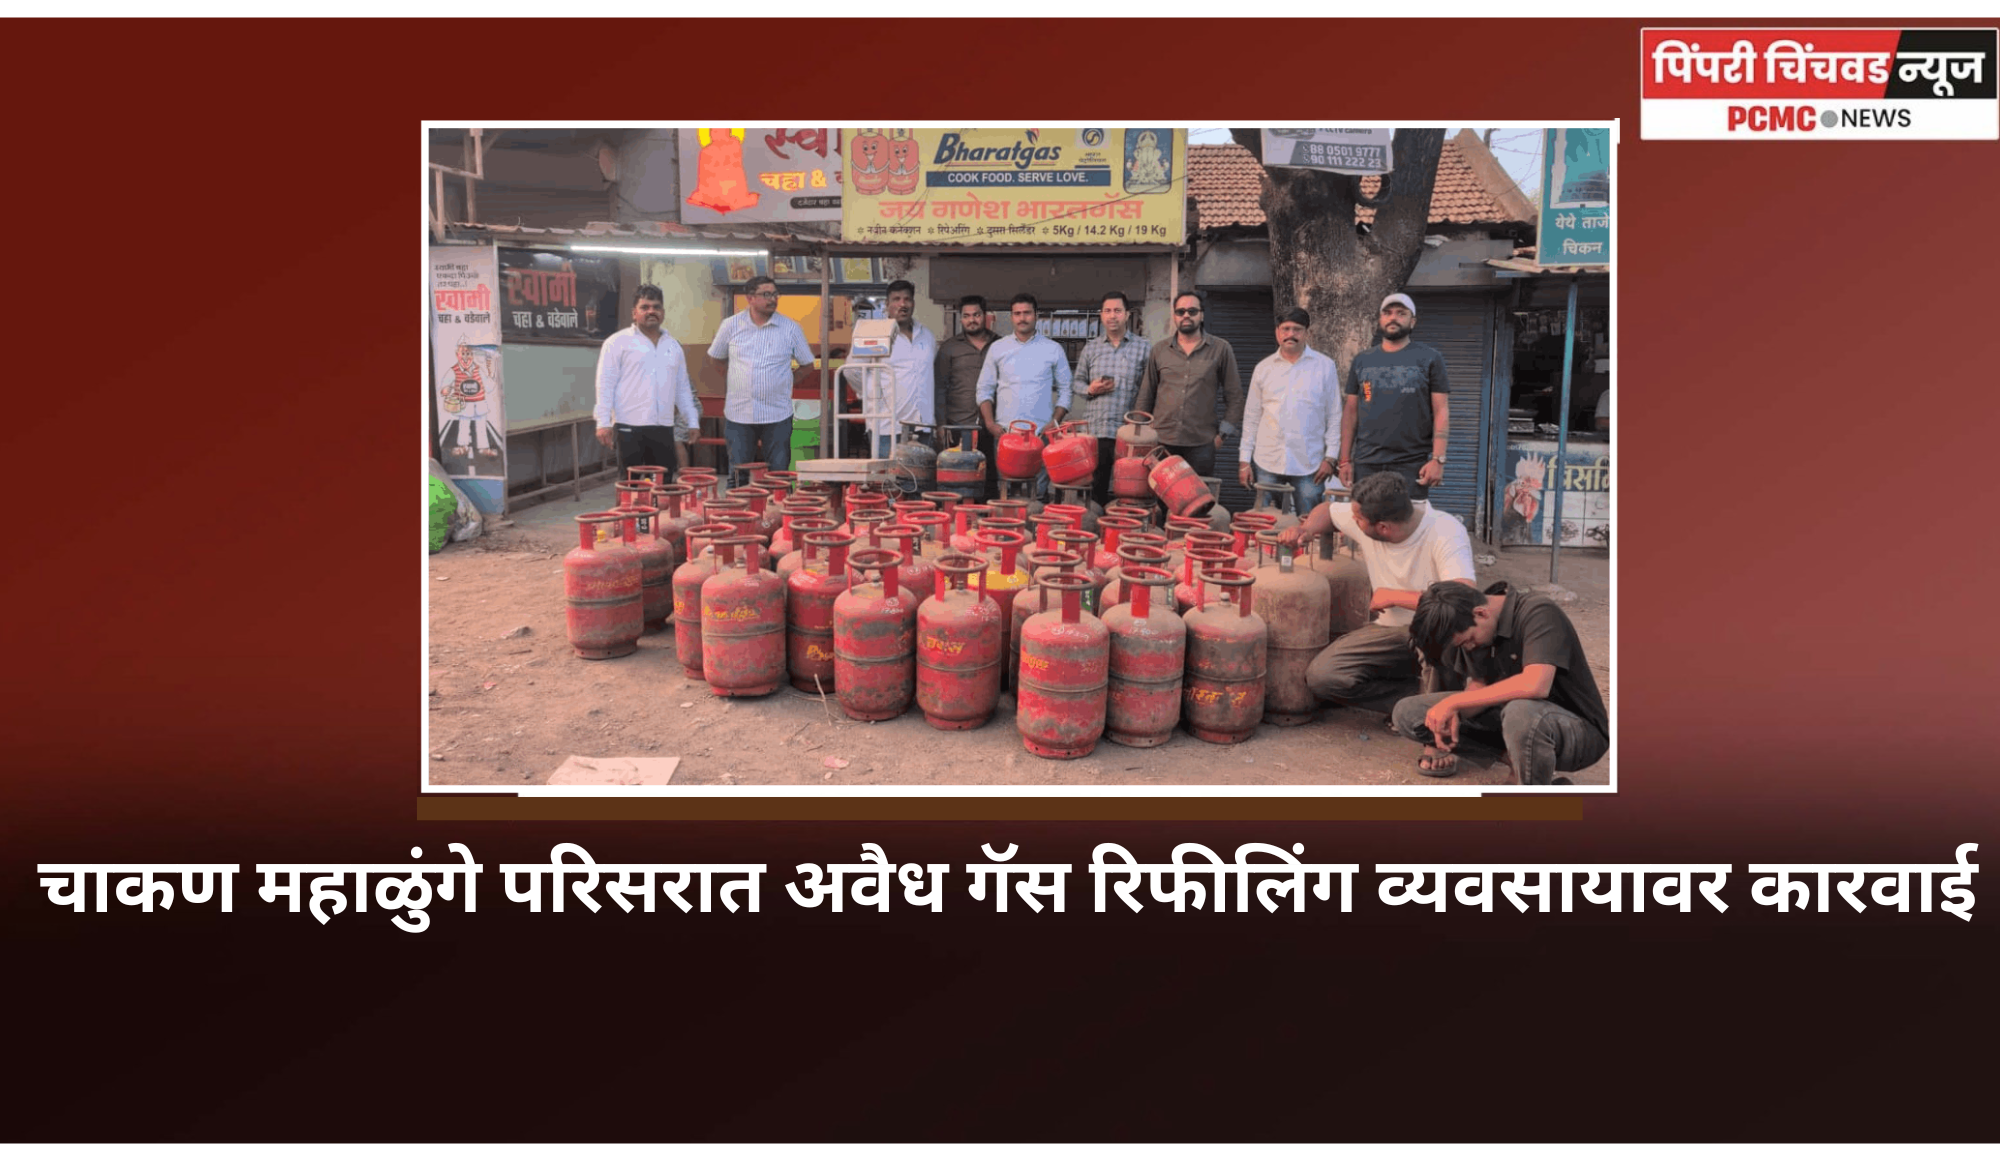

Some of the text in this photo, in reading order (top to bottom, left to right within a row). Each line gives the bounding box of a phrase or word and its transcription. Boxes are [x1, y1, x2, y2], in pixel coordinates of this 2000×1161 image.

[933, 133, 1062, 169] Bharatgas
[1310, 144, 1381, 157] 88 0501 9777
[1310, 155, 1324, 165] 90
[1345, 157, 1365, 167] 222
[948, 172, 1089, 182] COOK FOOD. SERVE LOVE.
[878, 191, 1144, 220] जय गणेश भारतगॅस
[1053, 225, 1074, 237] 5Kg
[1085, 225, 1106, 235] 14.2
[1110, 225, 1125, 237] Kg
[1136, 225, 1147, 235] 19
[1151, 225, 1166, 237] Kg
[1562, 238, 1604, 255] चिकन
[506, 261, 577, 307] स्वामी
[434, 284, 491, 311] स्वामी
[512, 311, 532, 328] चहा
[536, 315, 545, 328] &
